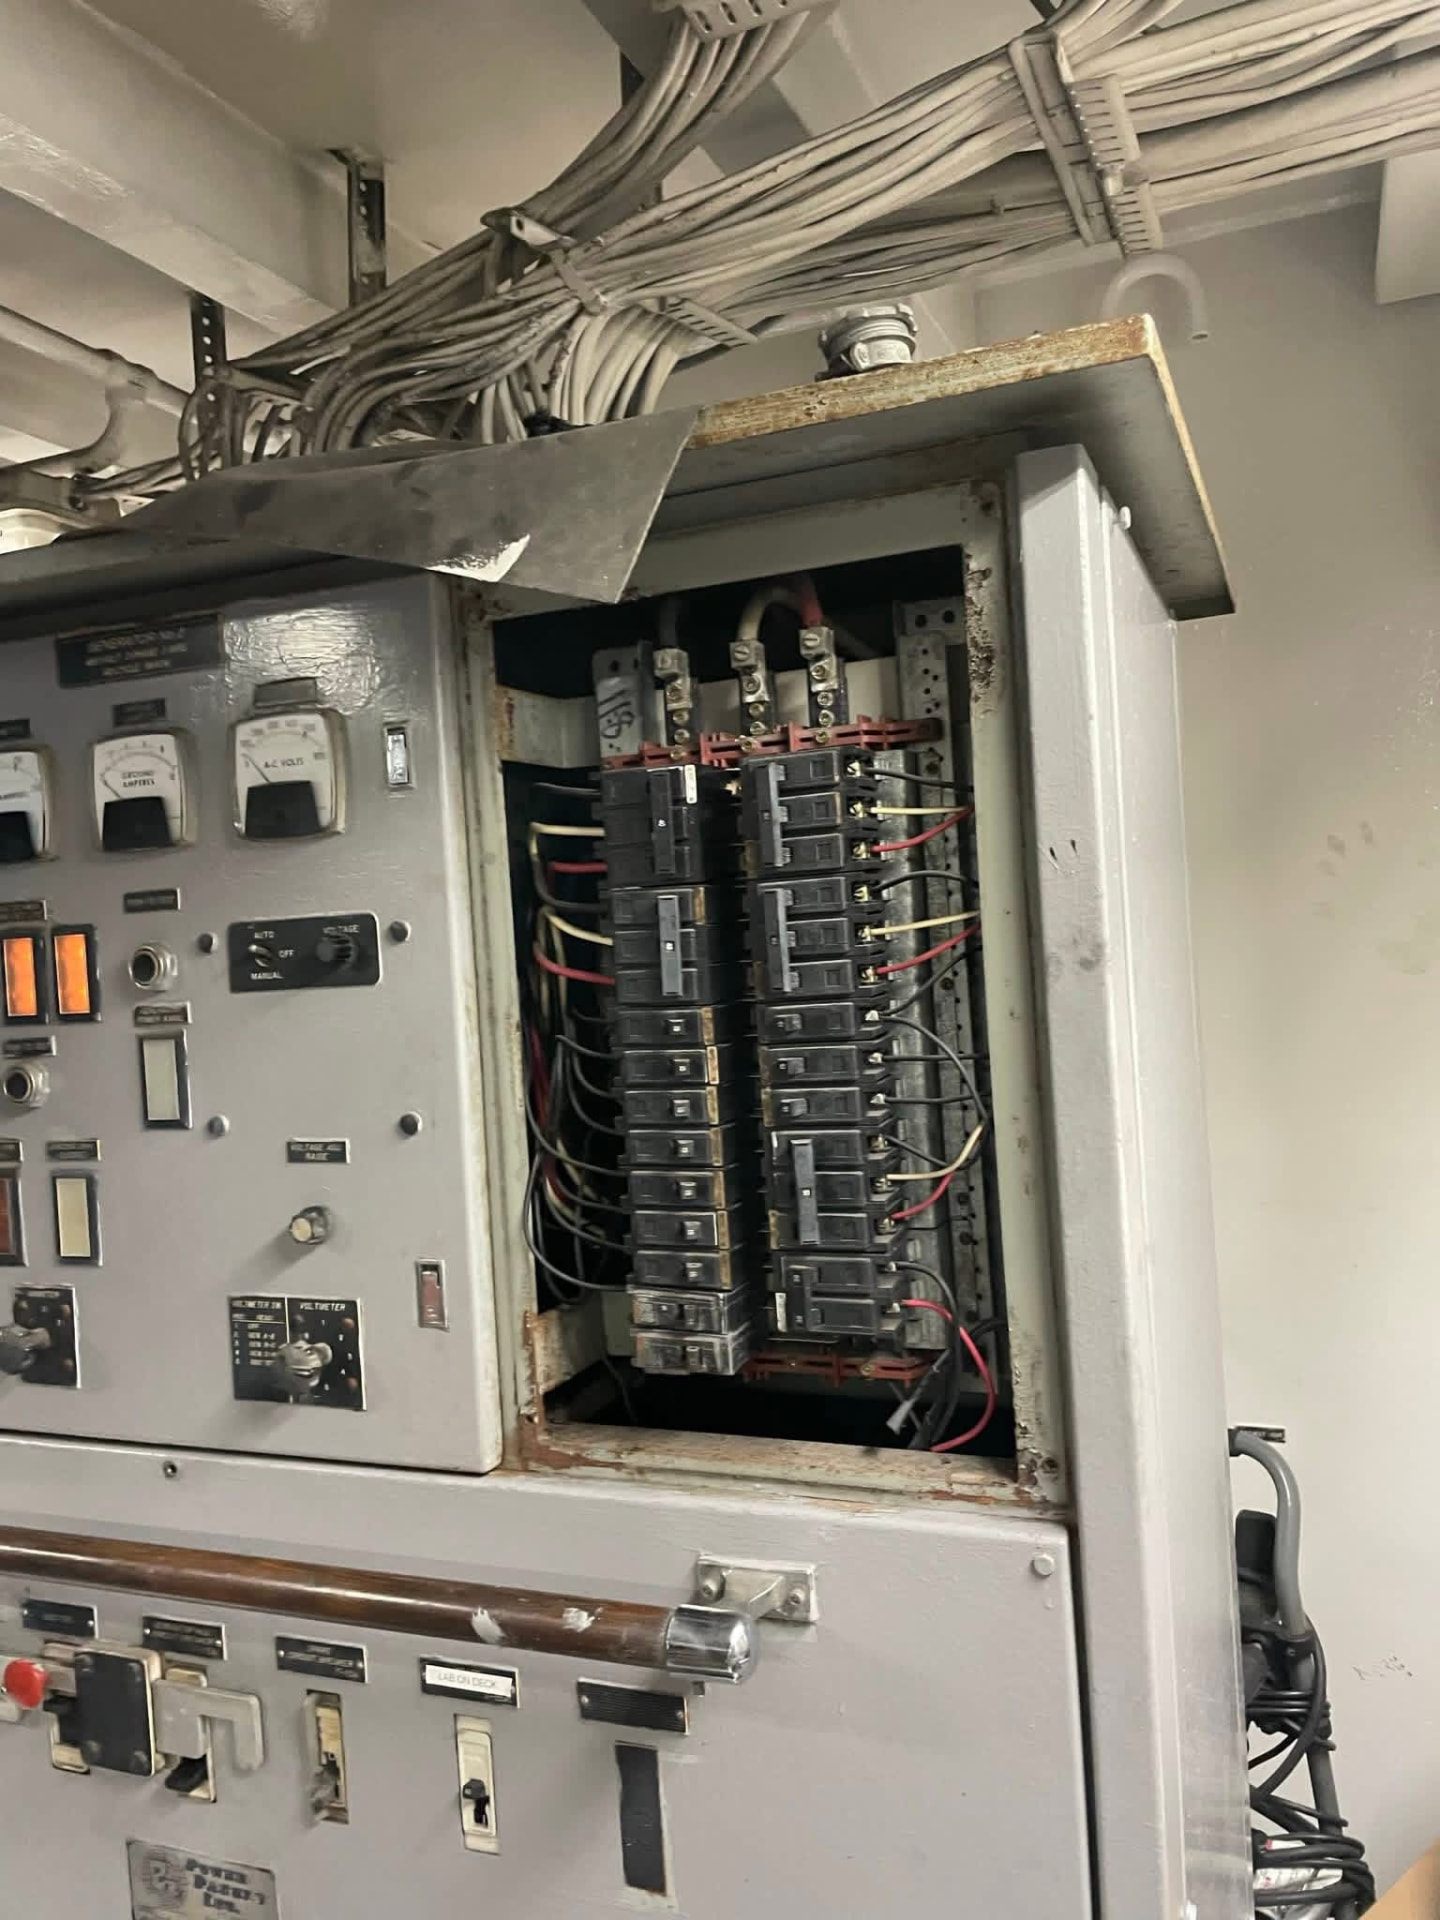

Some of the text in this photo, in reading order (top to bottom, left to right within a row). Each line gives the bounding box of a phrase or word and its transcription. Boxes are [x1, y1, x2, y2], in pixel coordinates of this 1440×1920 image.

[254, 930, 275, 939] AUTO
[278, 949, 295, 958] OFF
[299, 1302, 346, 1312] VOLTMETER
[437, 1672, 456, 1684] LAB
